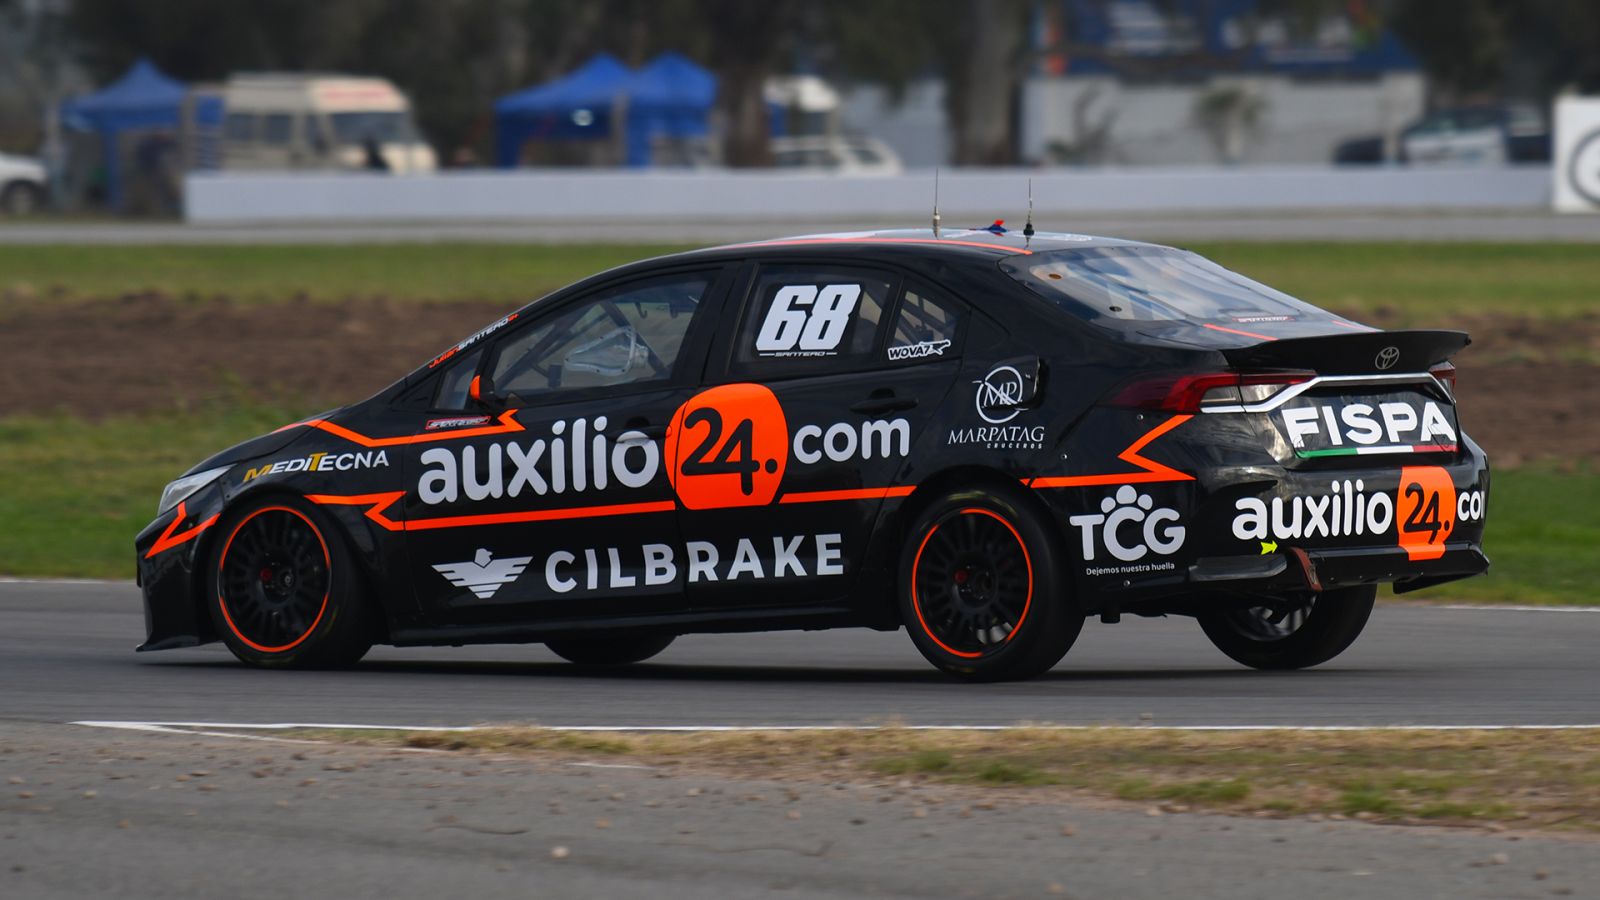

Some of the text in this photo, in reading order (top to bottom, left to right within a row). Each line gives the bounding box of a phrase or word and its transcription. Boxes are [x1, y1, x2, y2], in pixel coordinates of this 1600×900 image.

[756, 284, 861, 351] 68
[888, 345, 931, 360] WOVA7
[948, 426, 1045, 445] MARPATAG
[1281, 401, 1458, 448] FISPA
[1069, 506, 1186, 562] TCG
[544, 533, 845, 593] CILBRAKE
[1086, 562, 1175, 577] Dejemos nuestra huella
